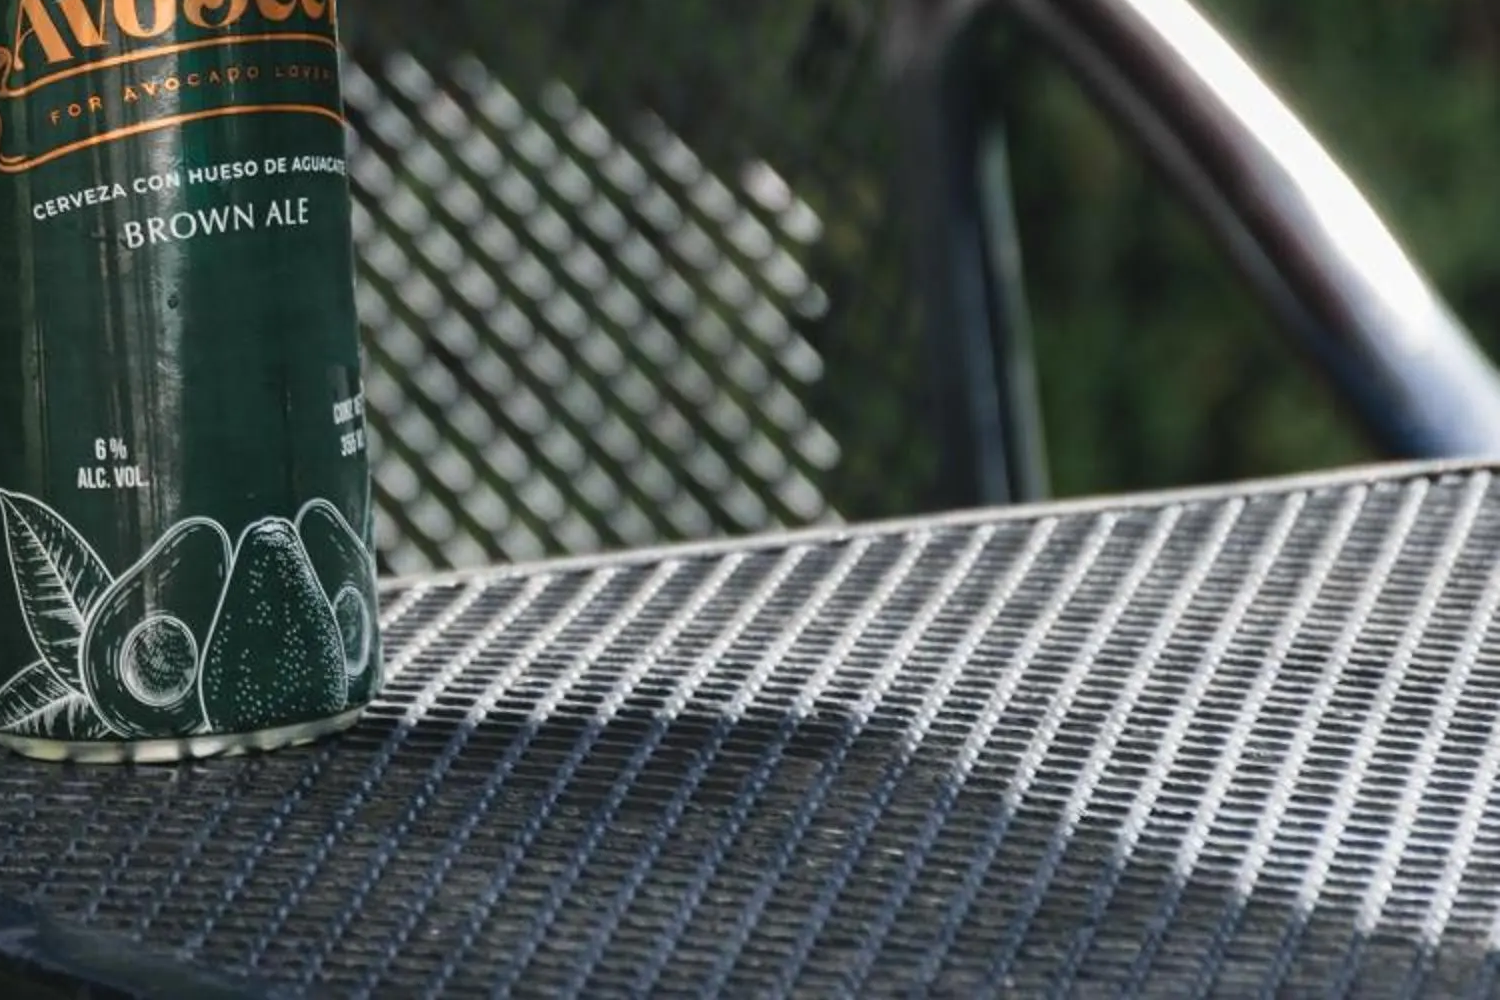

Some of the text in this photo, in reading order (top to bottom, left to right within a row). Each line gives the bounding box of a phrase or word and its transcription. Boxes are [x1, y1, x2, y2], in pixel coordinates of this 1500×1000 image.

[51, 95, 102, 126] FOR
[123, 65, 260, 102] AVOCADO
[33, 183, 127, 220] CERVEZA
[133, 172, 181, 193] CON
[188, 160, 258, 185] HUESO
[264, 157, 287, 174] DE
[124, 197, 309, 249] BROWN ALE
[95, 437, 107, 460] 6
[77, 466, 111, 489] ALC.
